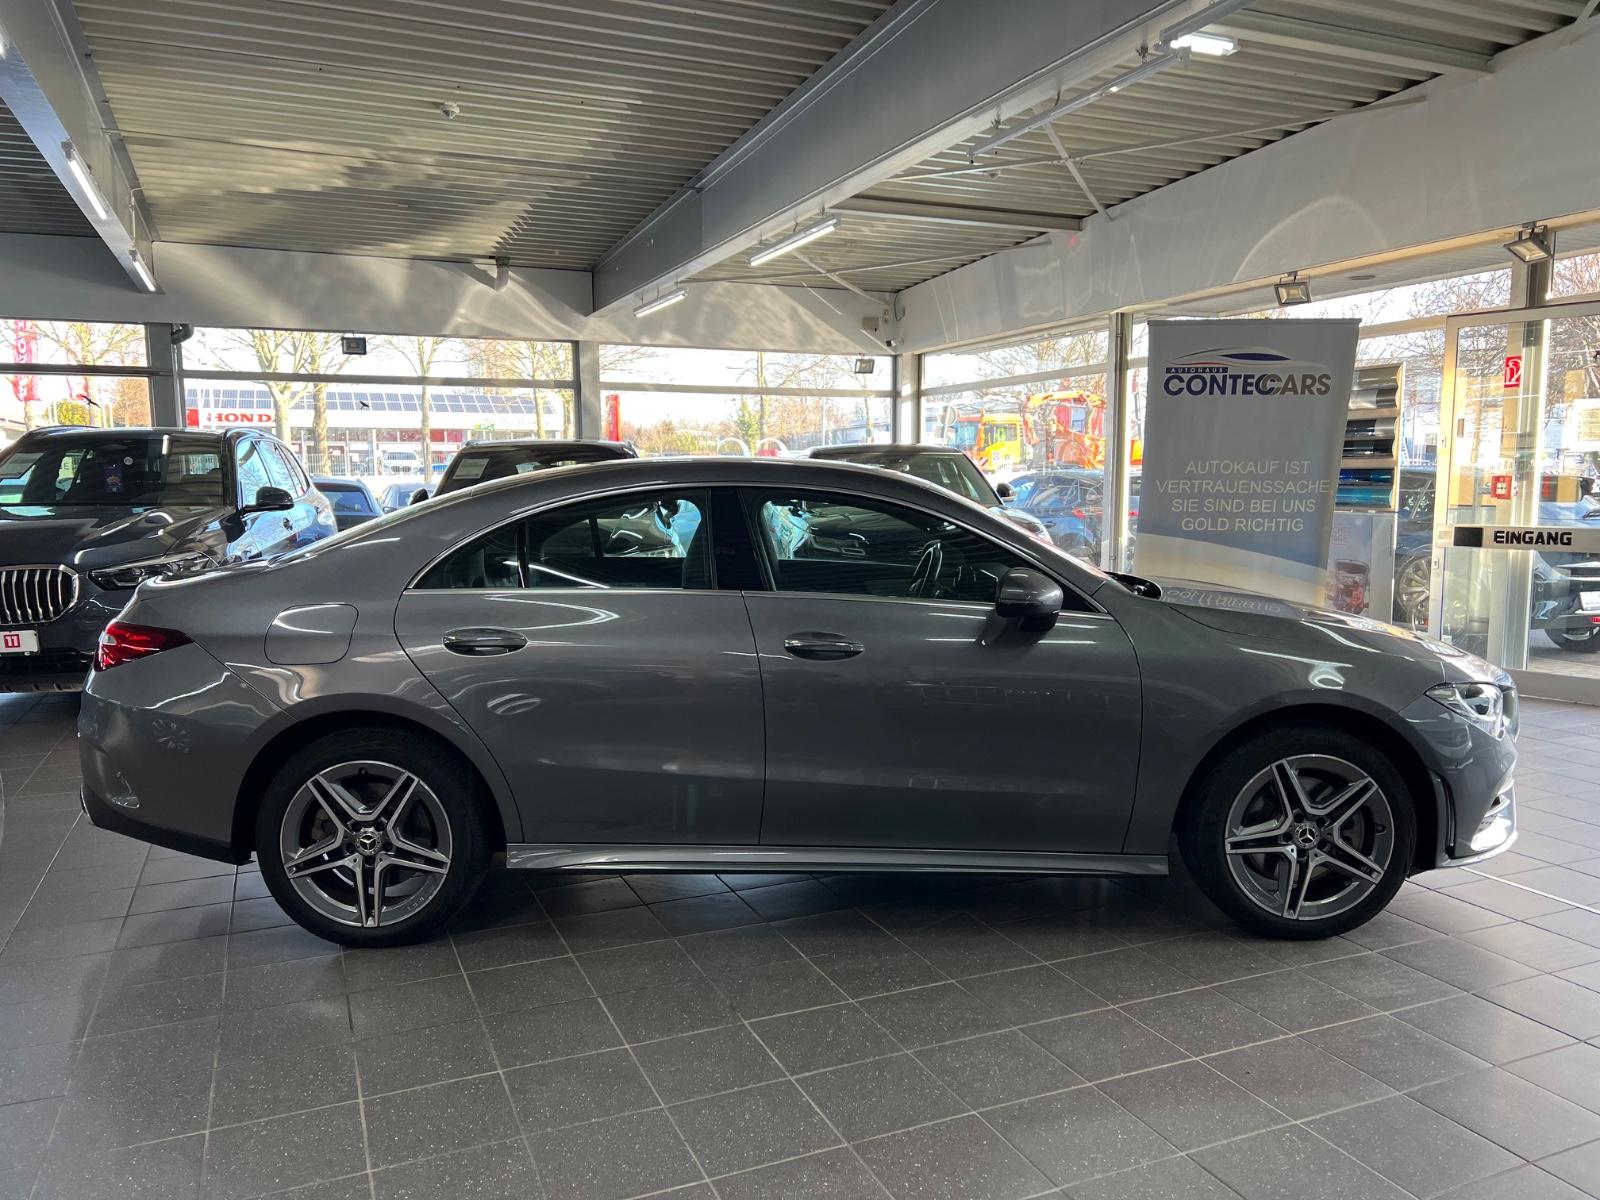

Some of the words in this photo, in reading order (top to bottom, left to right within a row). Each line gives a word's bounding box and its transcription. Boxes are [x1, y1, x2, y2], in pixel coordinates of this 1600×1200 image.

[207, 413, 276, 423] HOND
[1185, 461, 1280, 474] AUTOKAUF
[1285, 461, 1311, 474] IST
[1171, 499, 1199, 513] SIE
[1203, 500, 1245, 513] SIND
[1251, 500, 1277, 513] BEI
[1282, 500, 1316, 513] UNS
[1181, 518, 1229, 532] GOLD
[1234, 518, 1304, 532] RICHTIG
[1493, 530, 1573, 546] EINGANG
